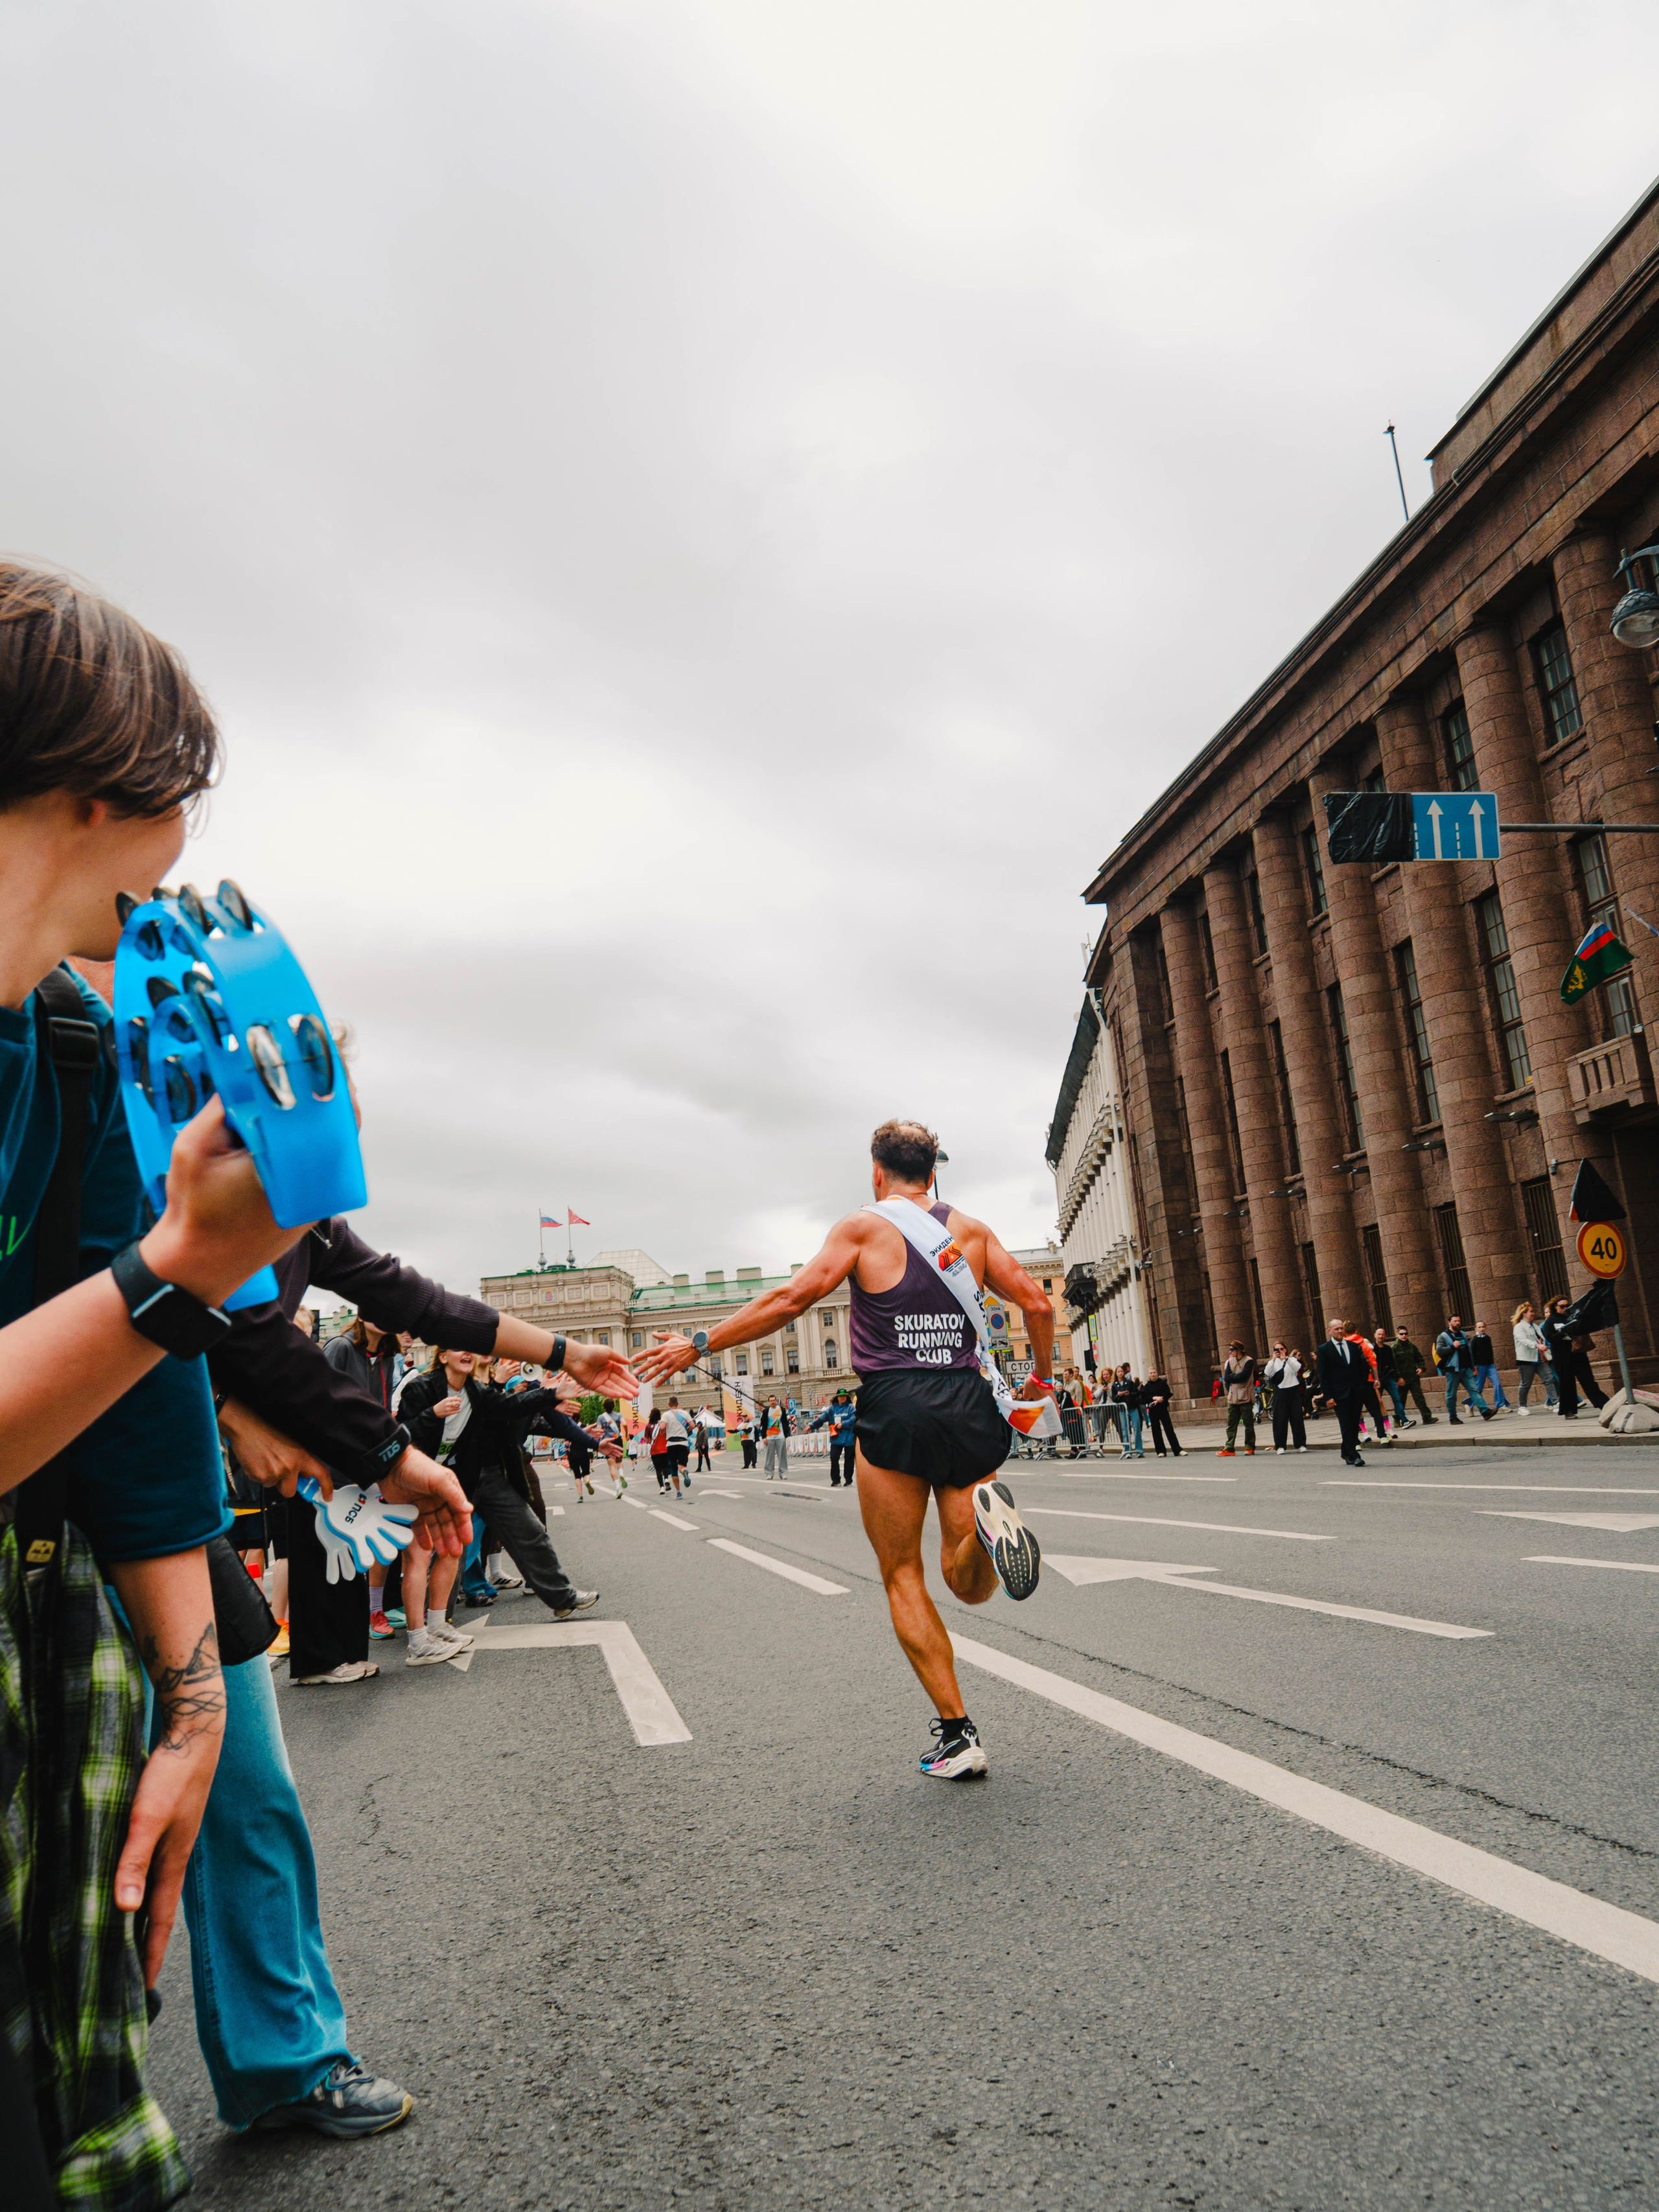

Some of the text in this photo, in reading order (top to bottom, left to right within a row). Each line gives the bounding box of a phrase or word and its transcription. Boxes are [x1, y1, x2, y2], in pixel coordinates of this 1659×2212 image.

[929, 1235, 954, 1257] ЭКИДЕН
[1590, 1237, 1617, 1260] 40
[894, 1313, 966, 1331] SKURATOV
[898, 1332, 962, 1349] RUNNING
[916, 1349, 952, 1364] CLUB
[734, 1381, 743, 1423] ЭКИДЕН
